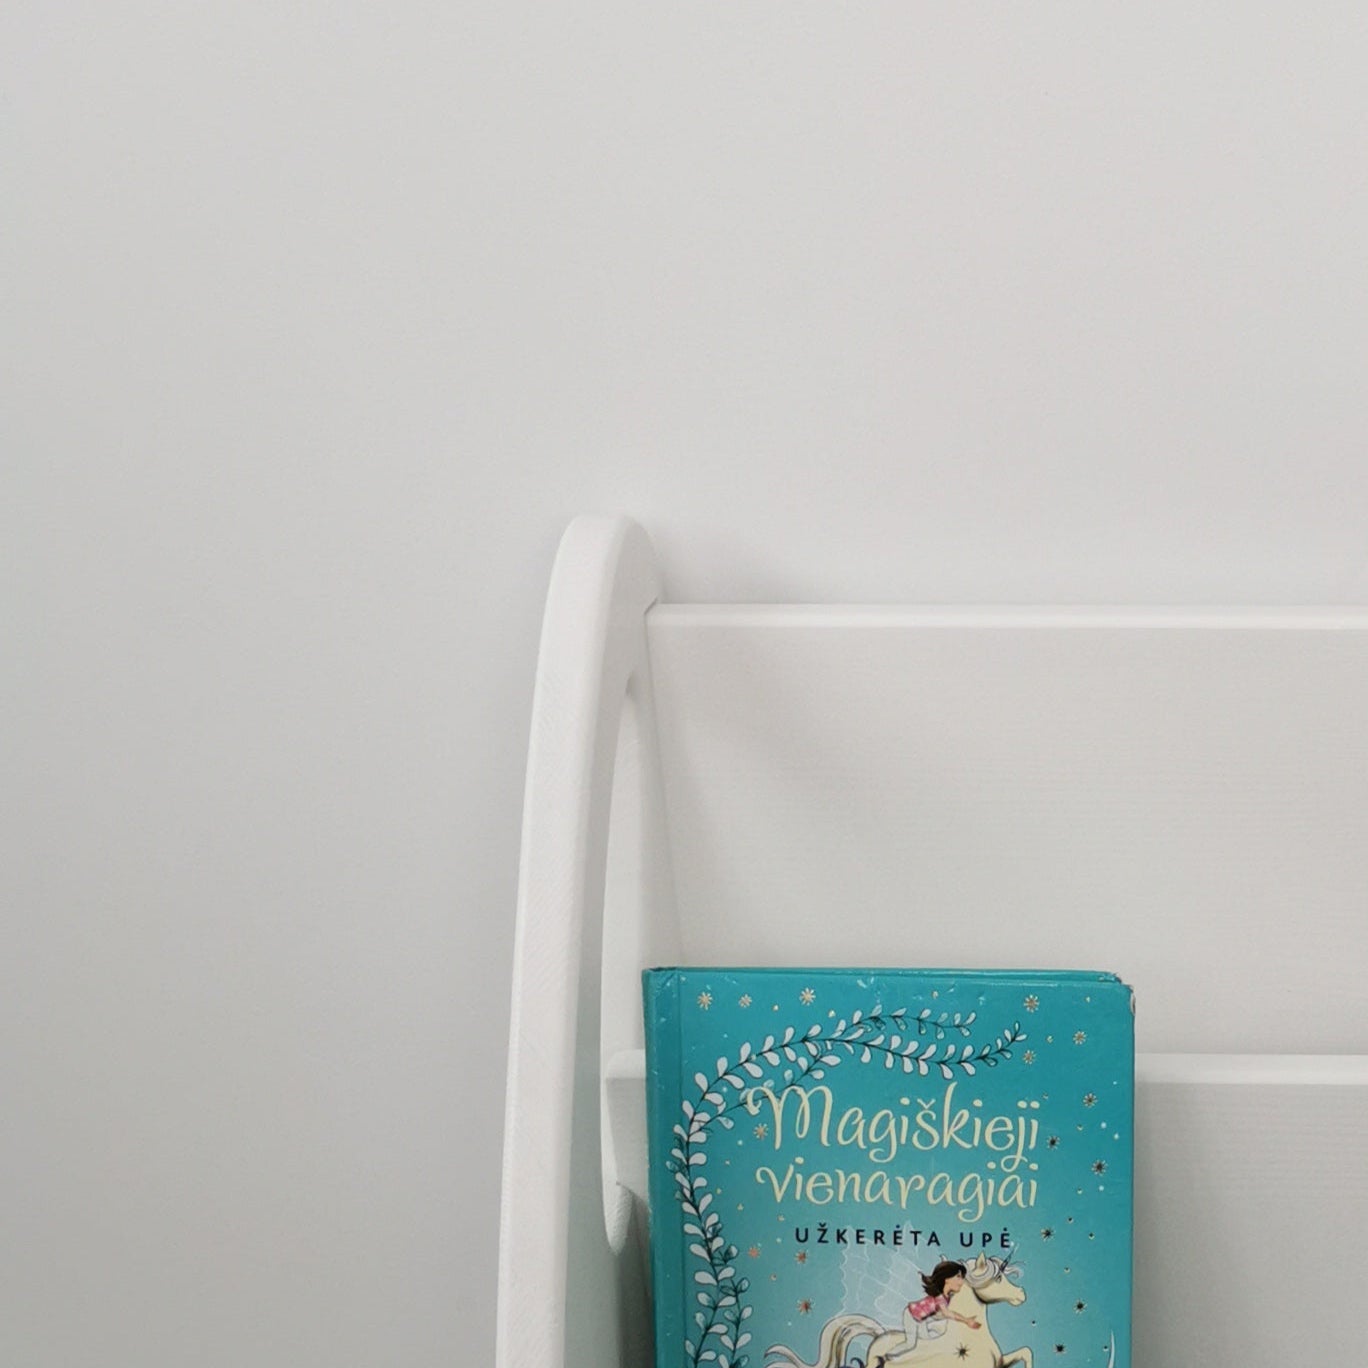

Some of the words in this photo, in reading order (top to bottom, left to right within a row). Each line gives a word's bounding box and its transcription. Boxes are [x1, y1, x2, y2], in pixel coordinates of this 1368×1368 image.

[746, 1082, 1040, 1172] Magiškieji
[755, 1157, 1039, 1222] vienaragiai
[795, 1223, 941, 1248] UŽKERĖTA
[959, 1227, 1011, 1249] UPĖ
